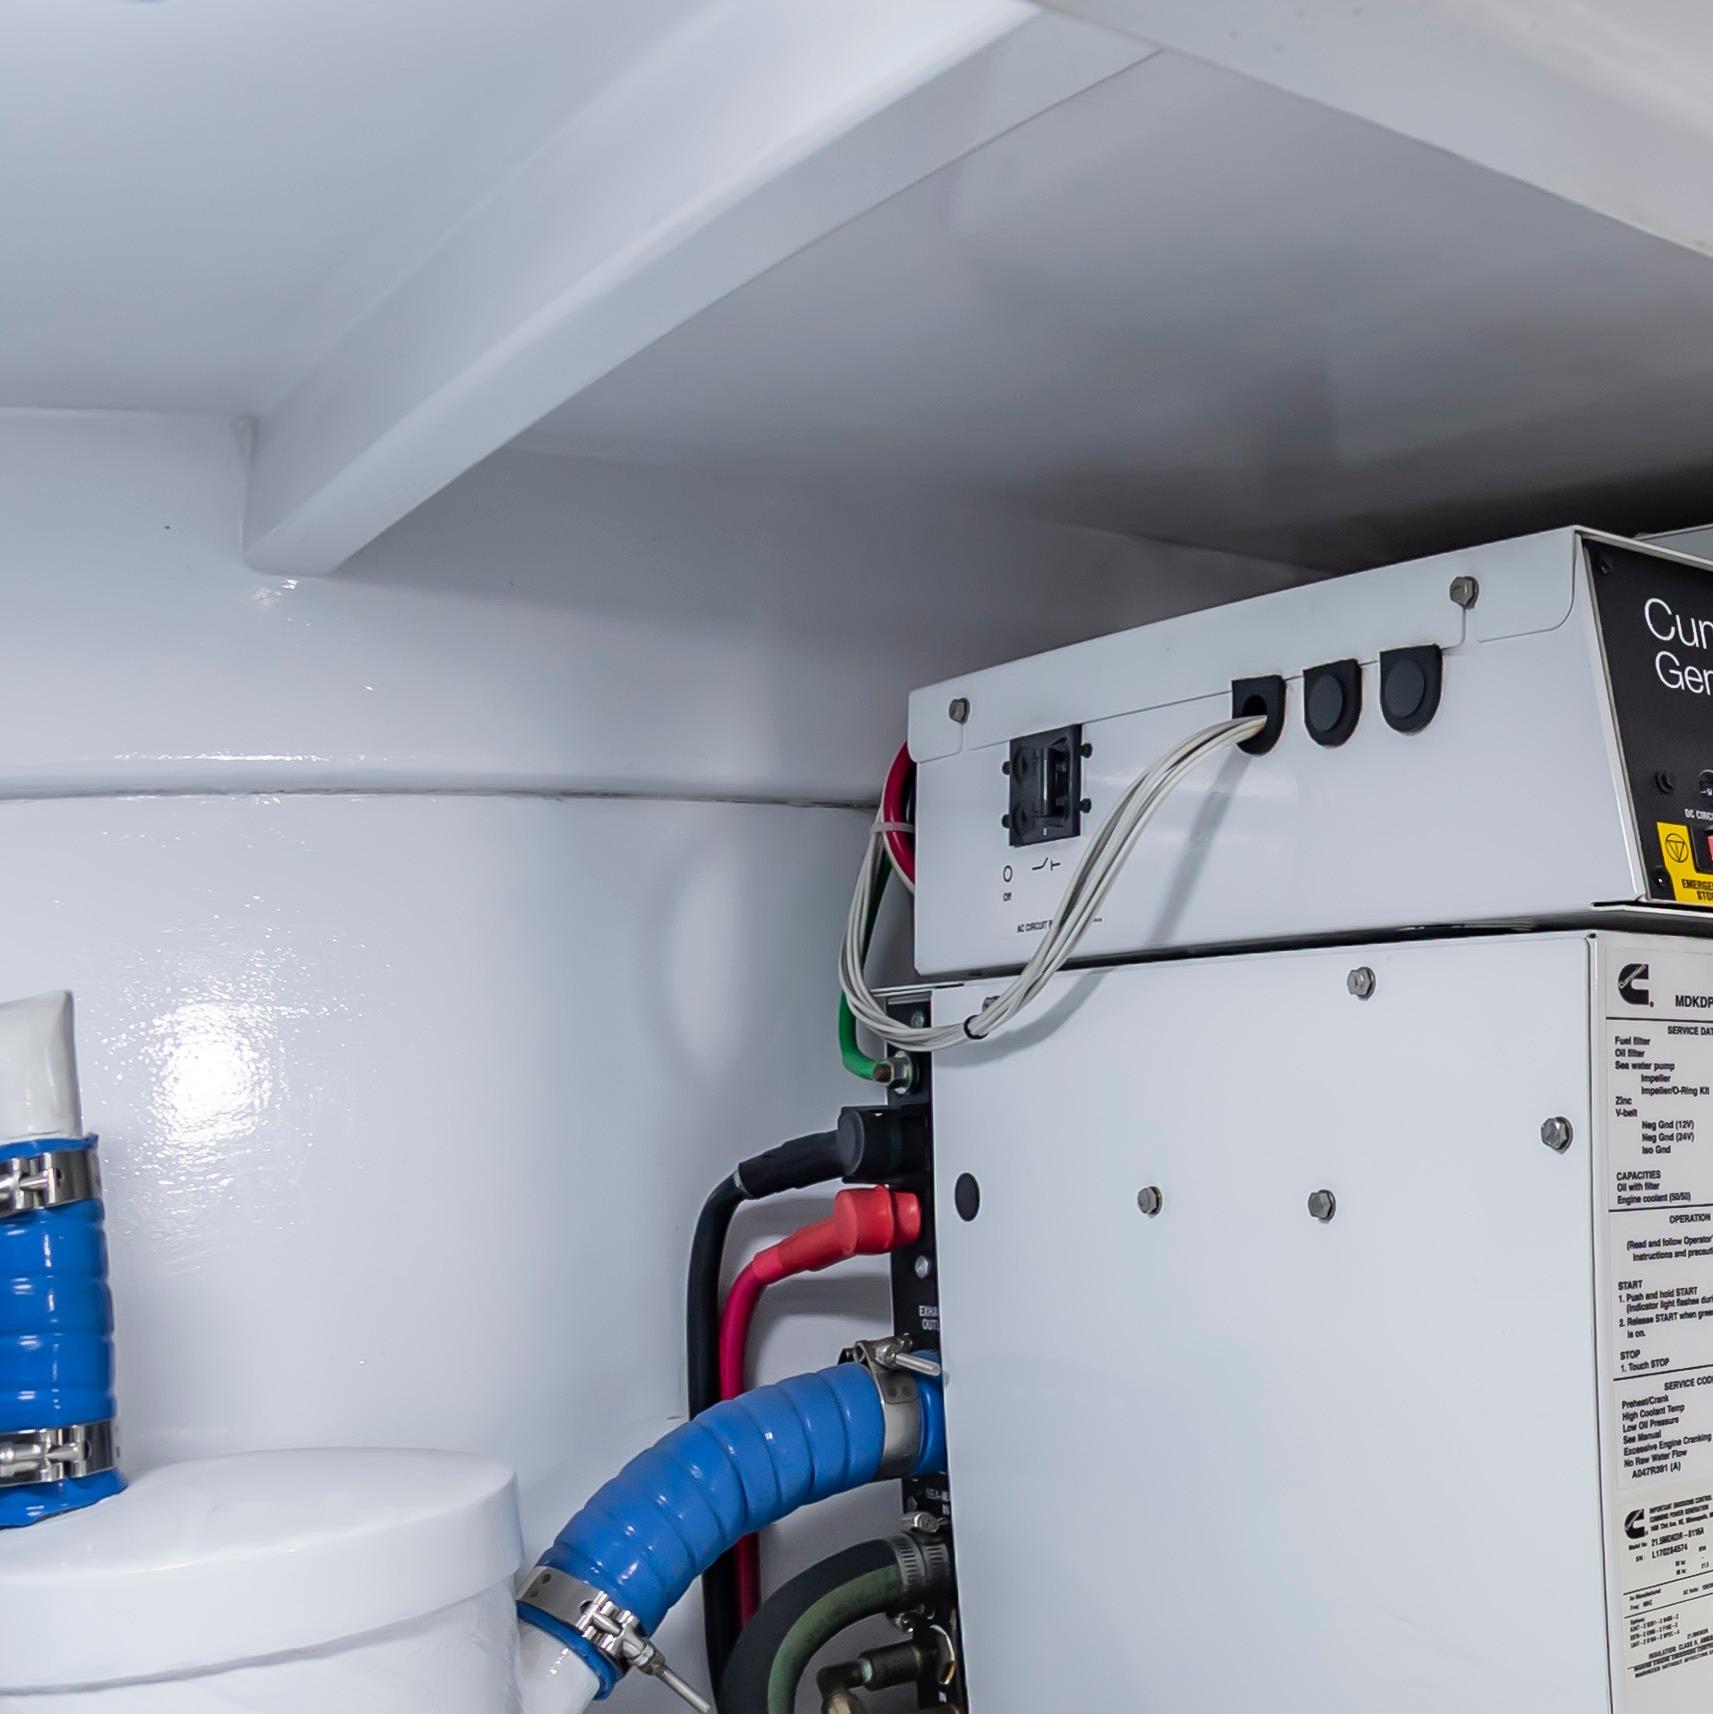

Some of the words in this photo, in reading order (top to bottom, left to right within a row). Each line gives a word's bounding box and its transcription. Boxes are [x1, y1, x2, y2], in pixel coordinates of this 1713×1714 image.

[1684, 809, 1694, 818] DC
[1667, 1026, 1699, 1035] SERVICE
[1615, 1036, 1631, 1045] Fuel
[1633, 1037, 1650, 1046] filter
[1615, 1049, 1626, 1057] Oil
[1628, 1049, 1645, 1058] filter
[1615, 1061, 1629, 1070] Sea
[1632, 1062, 1651, 1070] water
[1654, 1062, 1674, 1072] pump
[1641, 1074, 1671, 1083] Impeller
[1616, 1097, 1632, 1105] Zinc
[1616, 1109, 1637, 1117] V-belt
[1617, 1170, 1661, 1180] CAPACITIES
[1669, 1213, 1711, 1224] OPERATION
[1618, 1280, 1643, 1290] START
[1626, 1293, 1643, 1302] Push
[1645, 1292, 1658, 1300] and
[1660, 1290, 1674, 1298] hold
[1676, 1287, 1698, 1296] START
[1620, 1350, 1640, 1360] STOP
[1629, 1362, 1649, 1372] Touch
[1651, 1358, 1670, 1369] STOP
[1664, 1378, 1695, 1391] SERVICE
[1622, 1412, 1638, 1422] High
[1640, 1408, 1665, 1418] Coolant
[1667, 1404, 1685, 1414] Temp
[1623, 1424, 1637, 1433] Low
[1639, 1420, 1648, 1429] Oil
[1650, 1417, 1679, 1428] Pressure
[1623, 1435, 1636, 1444] See
[1638, 1430, 1661, 1441] Manual
[1659, 1438, 1681, 1450] Engine
[1624, 1458, 1633, 1468] No
[1635, 1455, 1650, 1465] Raw
[1652, 1452, 1670, 1462] Water
[1672, 1450, 1687, 1459] Flow
